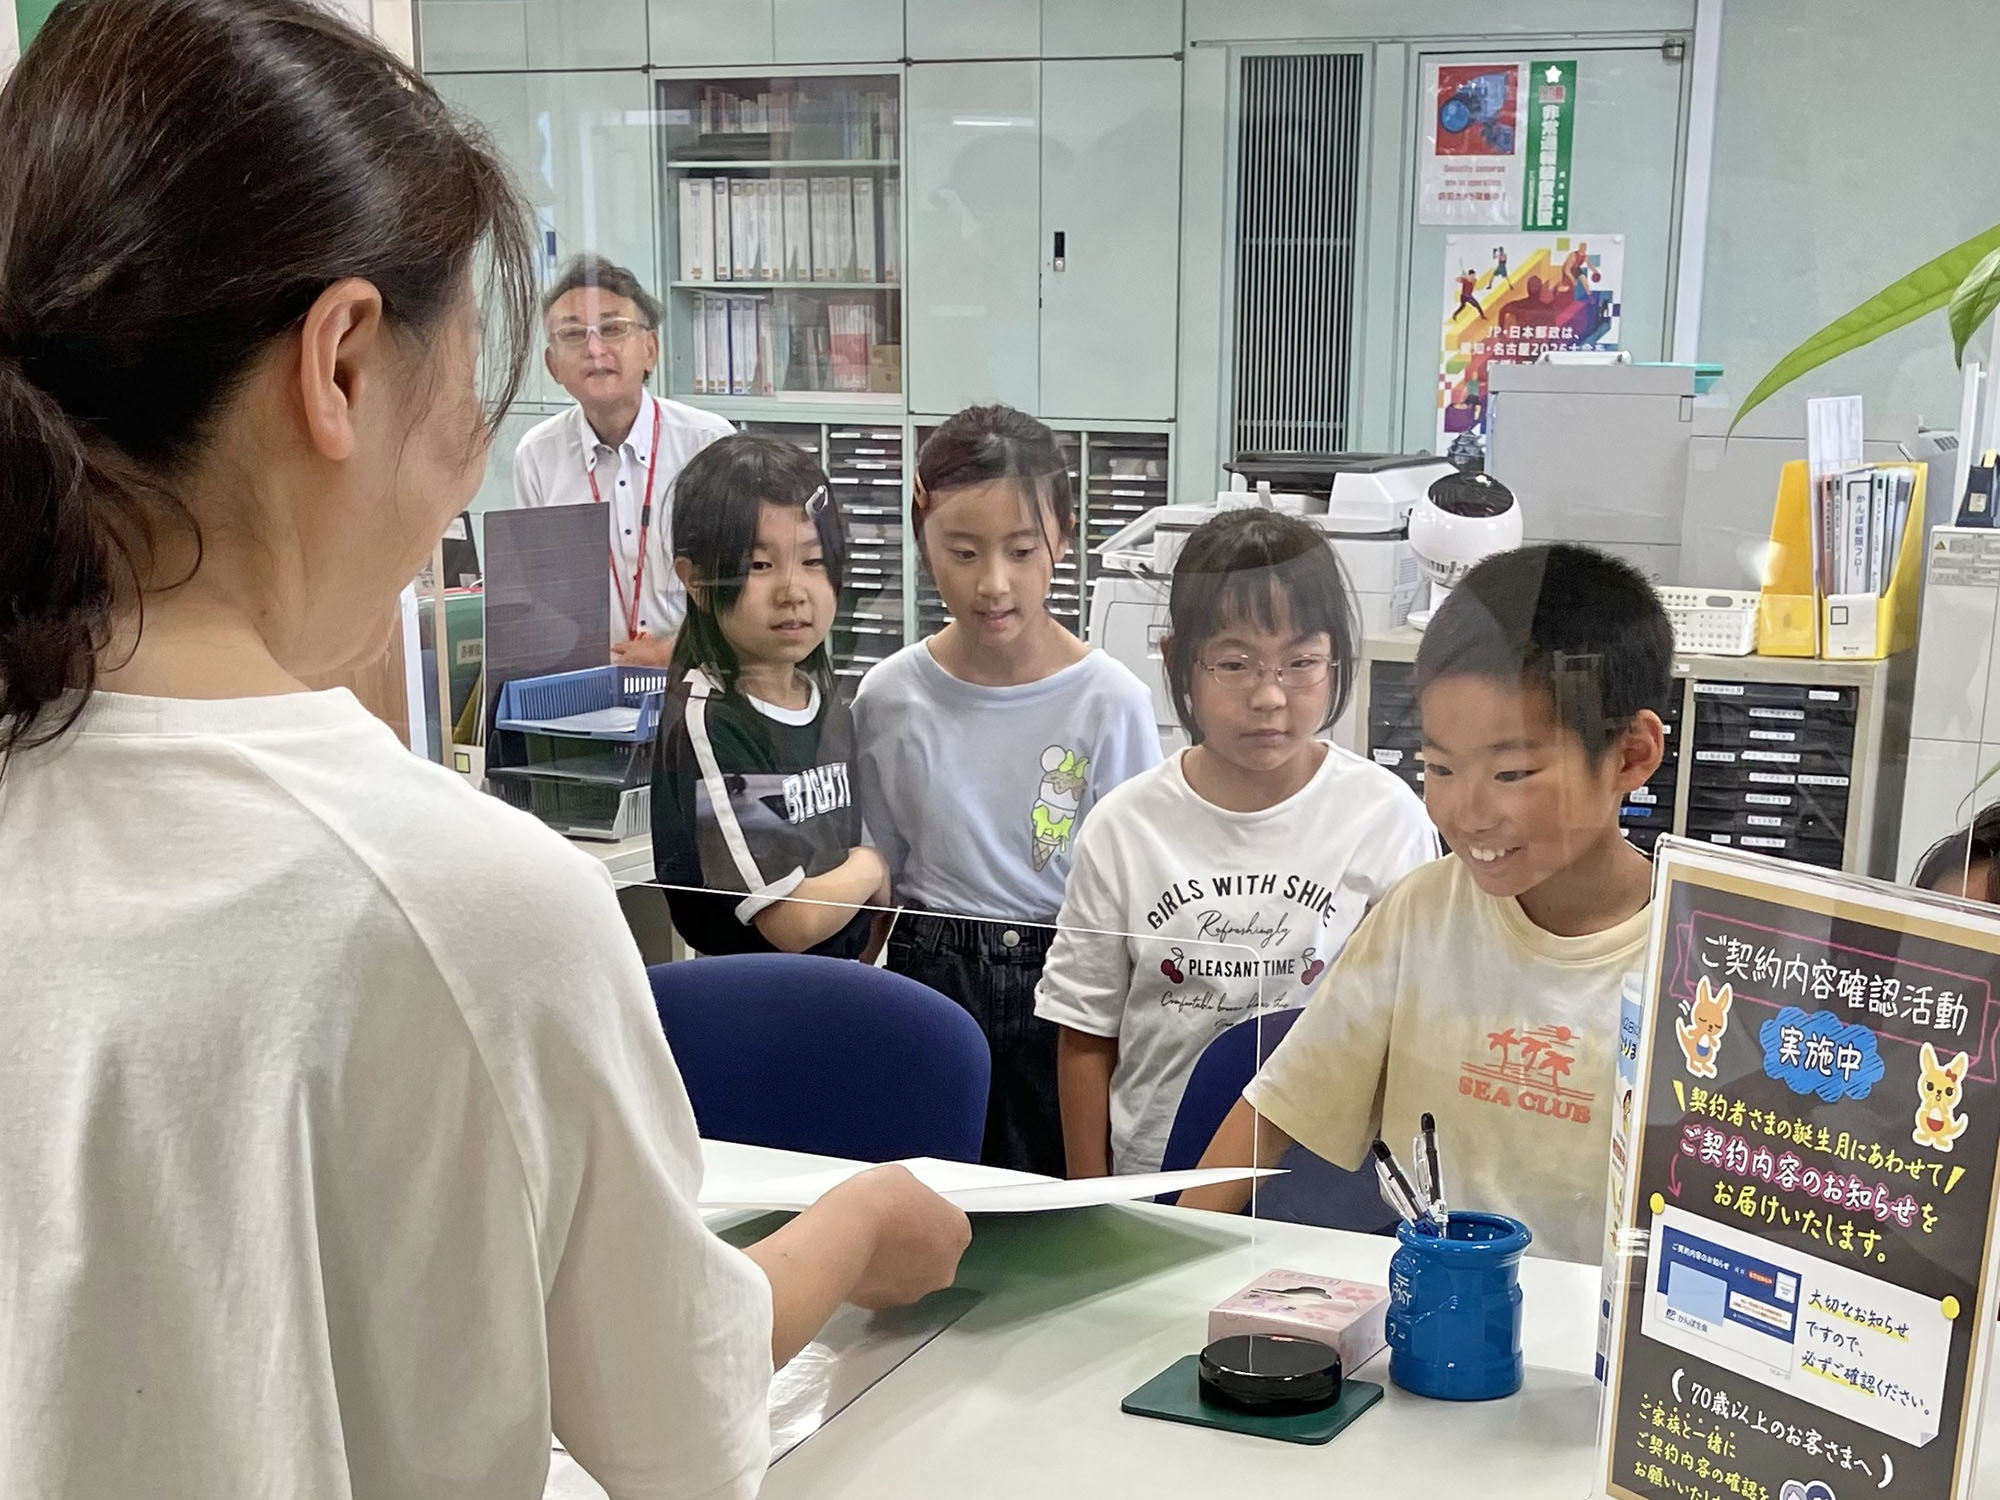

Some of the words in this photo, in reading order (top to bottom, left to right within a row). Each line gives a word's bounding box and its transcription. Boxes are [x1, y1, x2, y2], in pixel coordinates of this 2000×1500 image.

[1147, 879, 1204, 930] GIRLS
[1212, 874, 1277, 897] WITH
[1197, 909, 1292, 949] Refreshingly
[1189, 959, 1260, 978] PLEASANT
[1263, 959, 1296, 977] TIME
[1702, 934, 1968, 1037] ご契約内容確認活動
[1779, 1026, 1863, 1081] 実施中
[1459, 1076, 1512, 1107] SEA
[1517, 1091, 1592, 1124] CLUB
[1688, 1087, 1946, 1187] 契約者さまの誕生月にあわせて
[1680, 1126, 1939, 1233] ご契約内容のお知らせを
[1714, 1180, 1887, 1263] お届けいたします。
[1808, 1289, 1909, 1338] 大切なお知らせ
[1801, 1350, 1930, 1416] 必ずご確認ください。
[1639, 1397, 1736, 1458] ご家族と一緒に
[1635, 1431, 1769, 1500] ご契約内容の確認を
